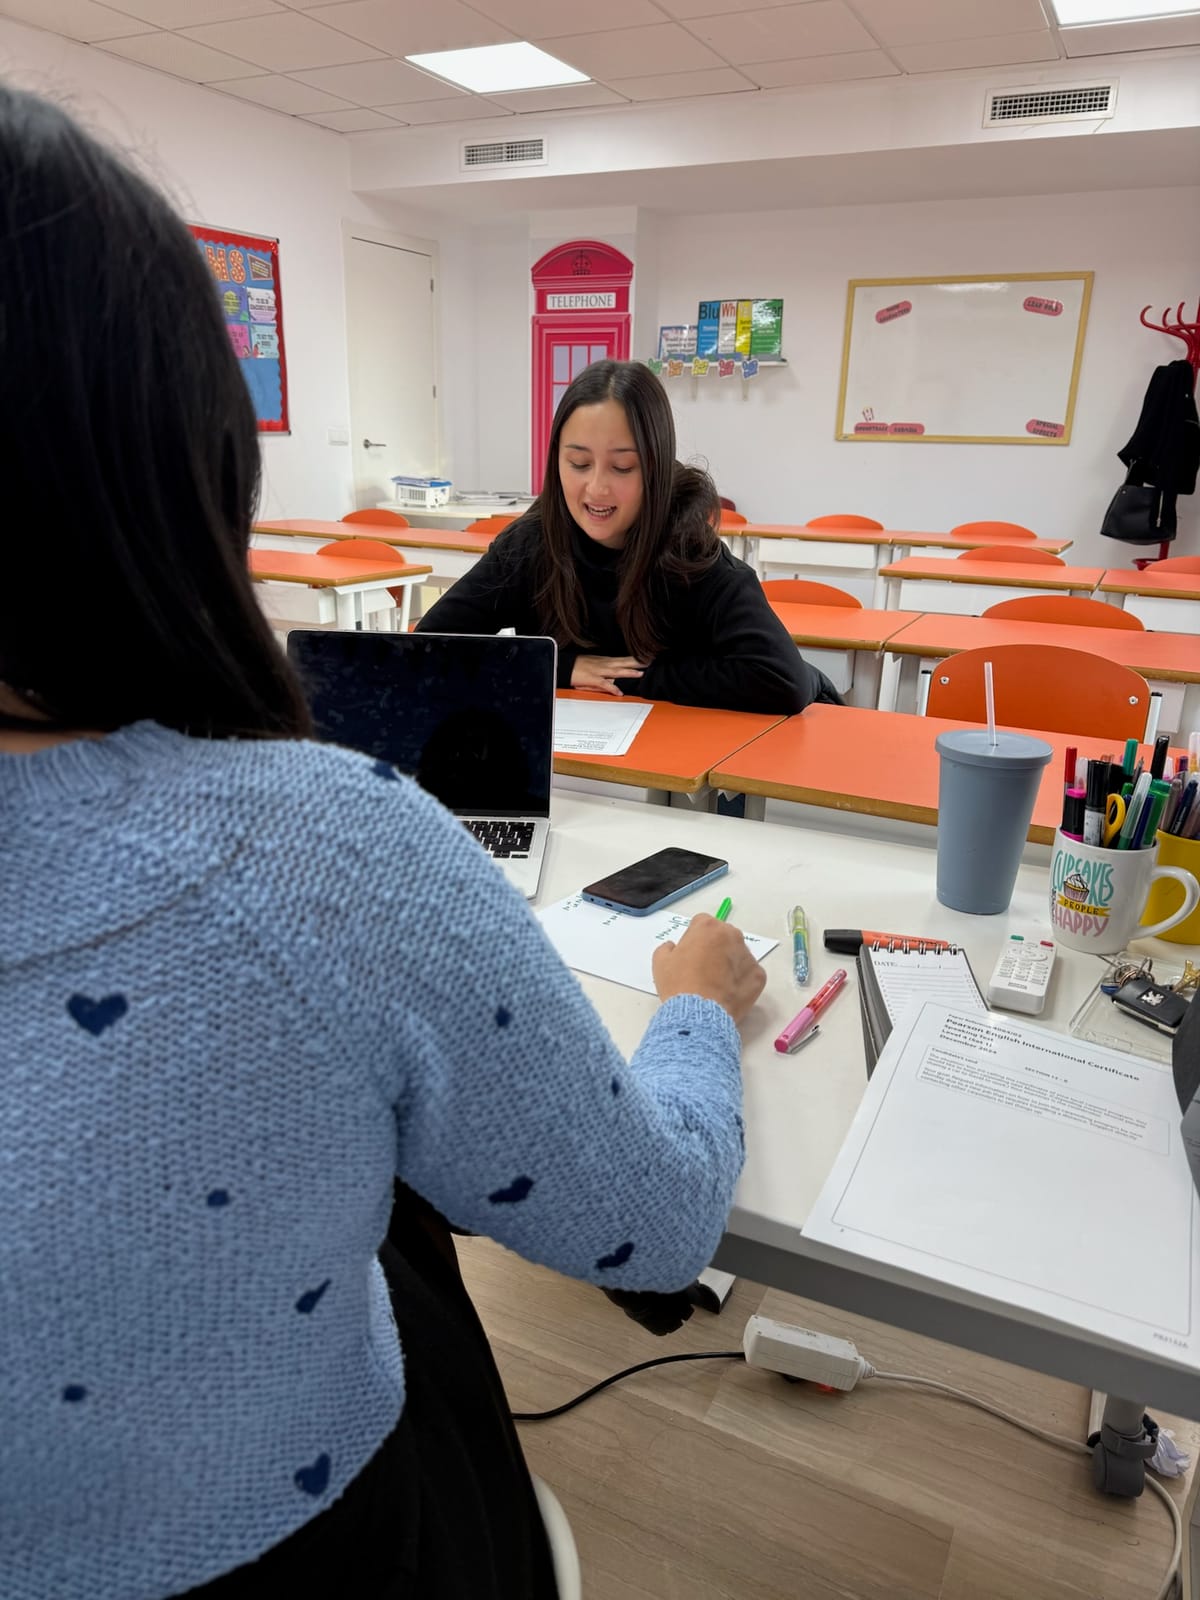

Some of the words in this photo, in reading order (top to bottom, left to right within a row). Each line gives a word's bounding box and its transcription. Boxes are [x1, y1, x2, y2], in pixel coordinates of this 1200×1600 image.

[550, 294, 614, 308] TELEPHONE
[1053, 850, 1115, 907] CUPCAKES
[1063, 899, 1100, 916] PEOPLE
[1054, 904, 1110, 937] HAPPY
[940, 1034, 977, 1048] December
[946, 1018, 984, 1033] Pearson
[985, 1030, 1021, 1044] English
[1022, 1040, 1086, 1065] International
[1087, 1061, 1140, 1081] Certificate
